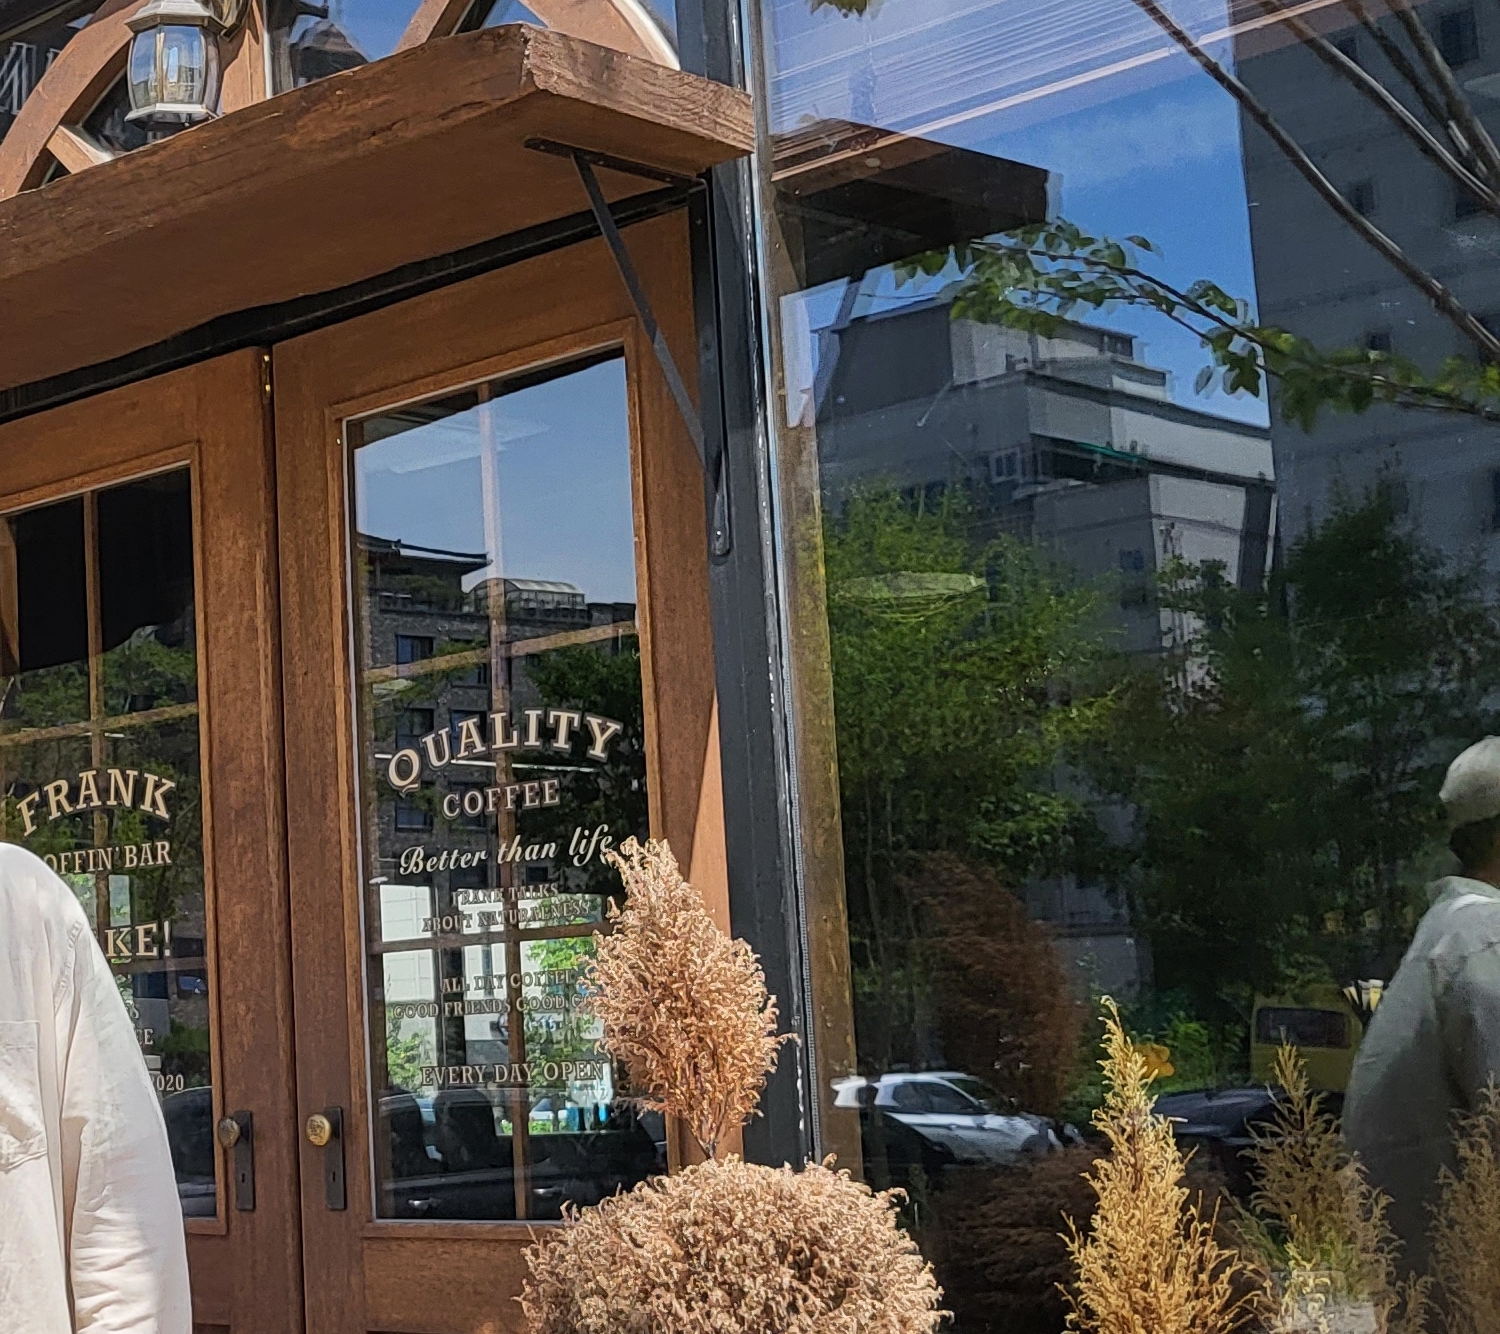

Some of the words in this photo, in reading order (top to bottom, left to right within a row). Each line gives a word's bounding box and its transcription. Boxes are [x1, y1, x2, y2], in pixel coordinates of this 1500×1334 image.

[388, 709, 621, 795] QUALITY
[16, 768, 175, 837] FRANK
[443, 779, 560, 818] COFFEE
[43, 847, 120, 875] OFFIN'
[124, 841, 173, 868] BAR
[400, 845, 488, 876] Better
[497, 835, 557, 866] than
[451, 887, 505, 907] FRANK
[508, 883, 560, 902] TALKS
[421, 913, 473, 933] ABOUT
[477, 899, 592, 928] NATURALNESS
[103, 920, 171, 958] KE!
[440, 977, 470, 994] ALL
[474, 974, 505, 991] DAY
[392, 1003, 439, 1019] GOOD
[444, 998, 511, 1017] FRIENDS
[516, 994, 565, 1012] GOOD
[153, 1073, 185, 1091] 020
[421, 1065, 486, 1086] EVERY
[494, 1063, 535, 1084] DAY
[543, 1058, 605, 1081] OPEN
